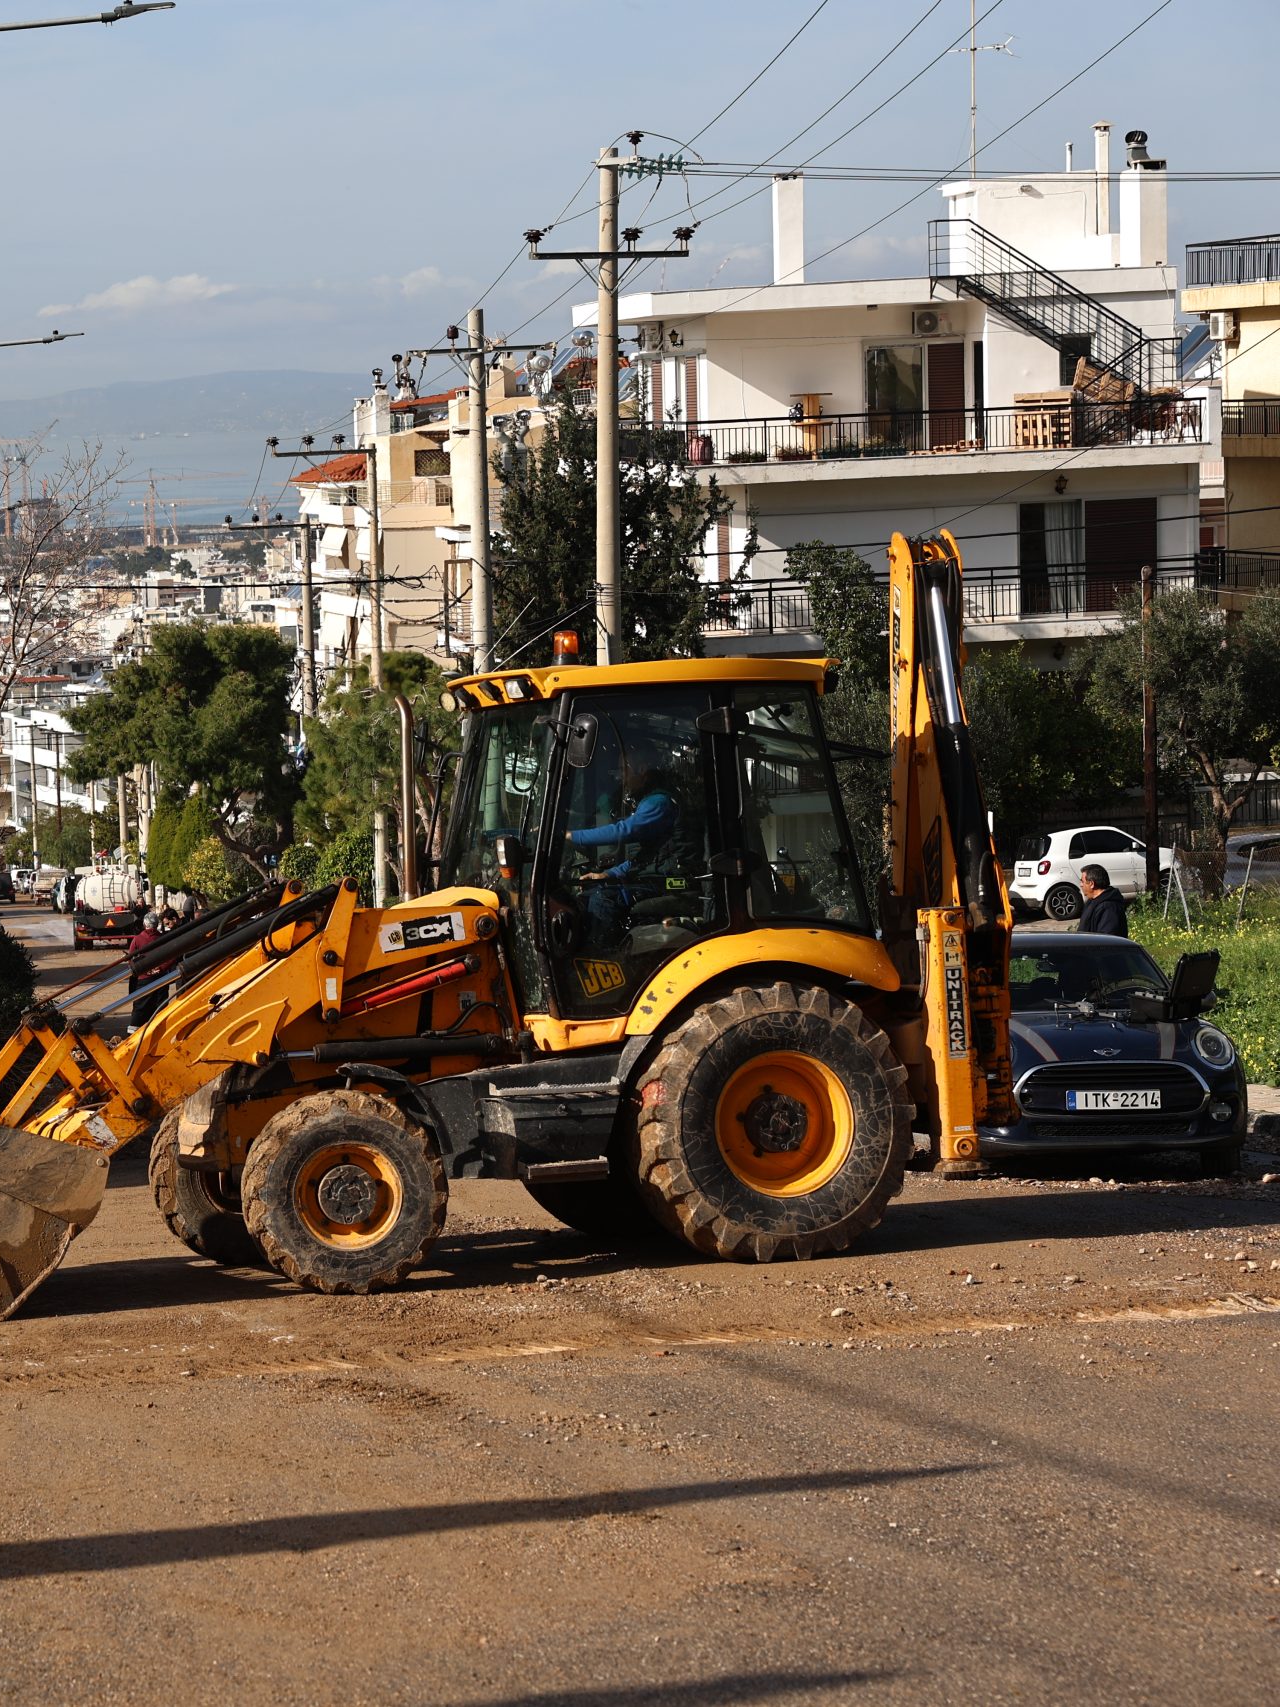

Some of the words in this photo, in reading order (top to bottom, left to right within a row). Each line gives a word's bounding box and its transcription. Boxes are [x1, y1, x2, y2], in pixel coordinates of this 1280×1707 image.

[406, 922, 451, 941] 3CX
[583, 962, 622, 994] JCB
[947, 969, 966, 1052] UNITRACK
[1084, 1092, 1159, 1108] ITK-2214
